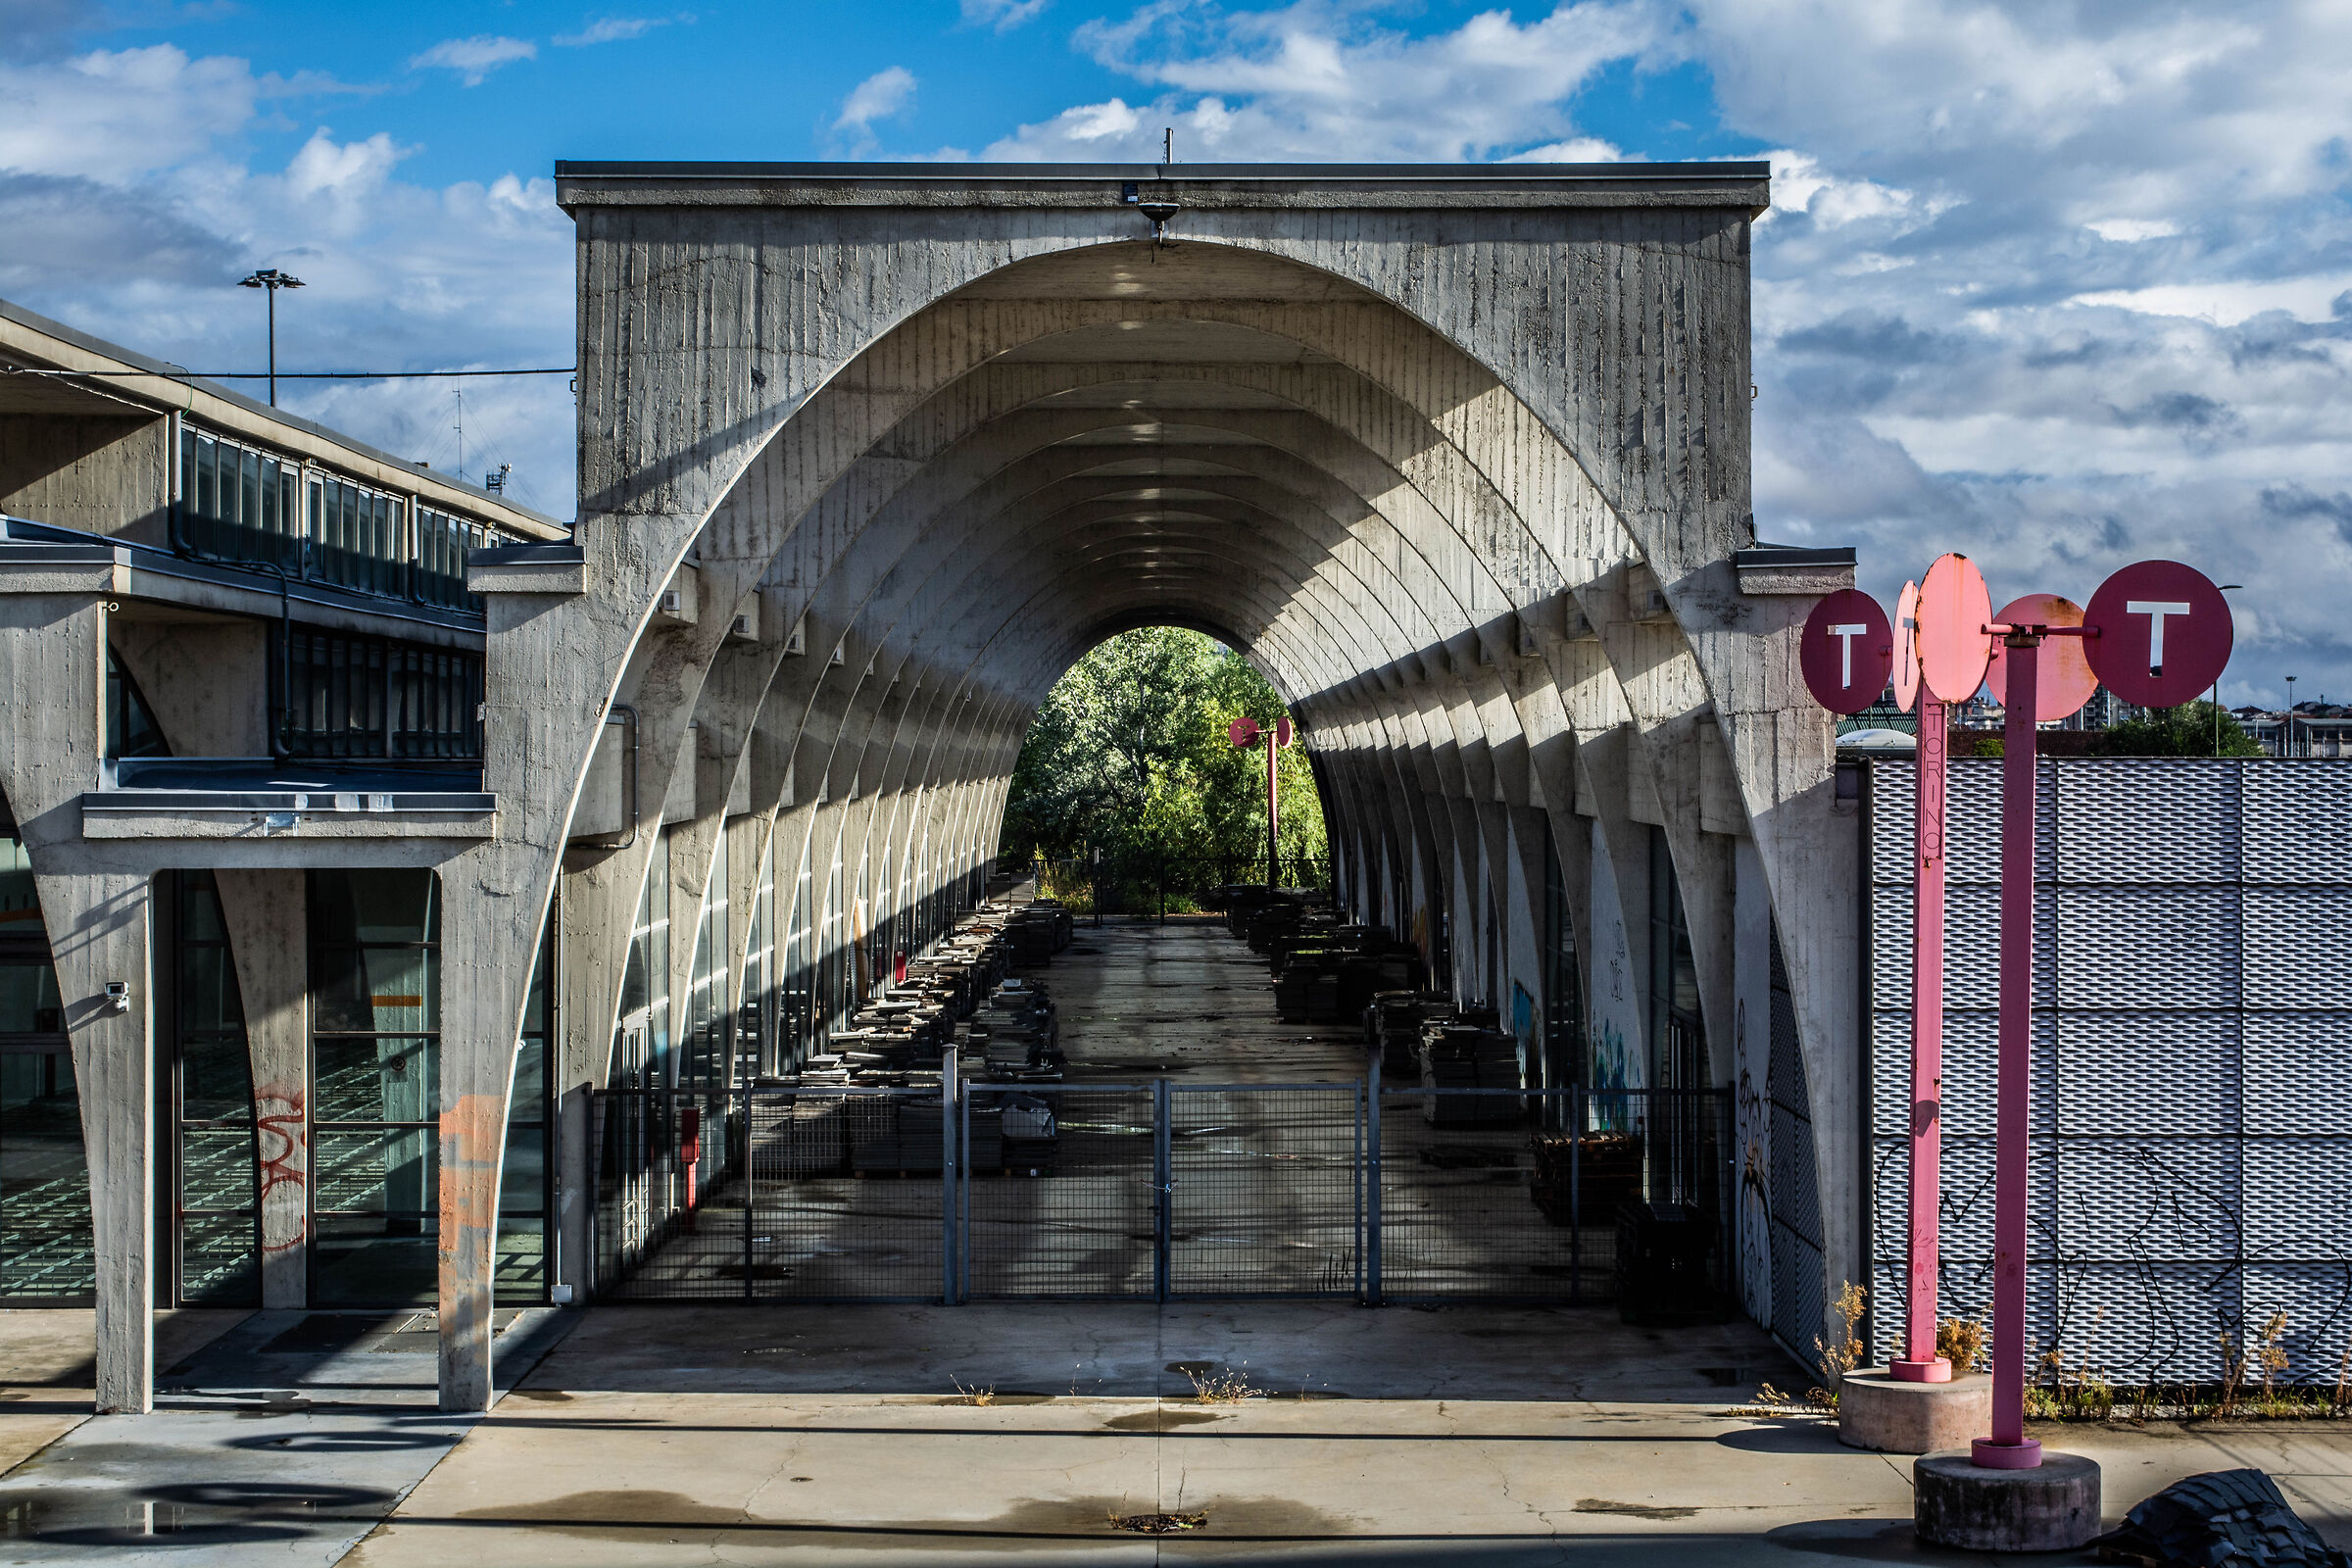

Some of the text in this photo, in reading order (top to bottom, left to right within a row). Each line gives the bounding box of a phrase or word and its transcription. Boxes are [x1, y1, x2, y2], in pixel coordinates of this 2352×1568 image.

[1827, 623, 1867, 689] T
[2127, 601, 2190, 677] T
[1237, 725, 1250, 741] T
[1923, 712, 1943, 850] TORINO
